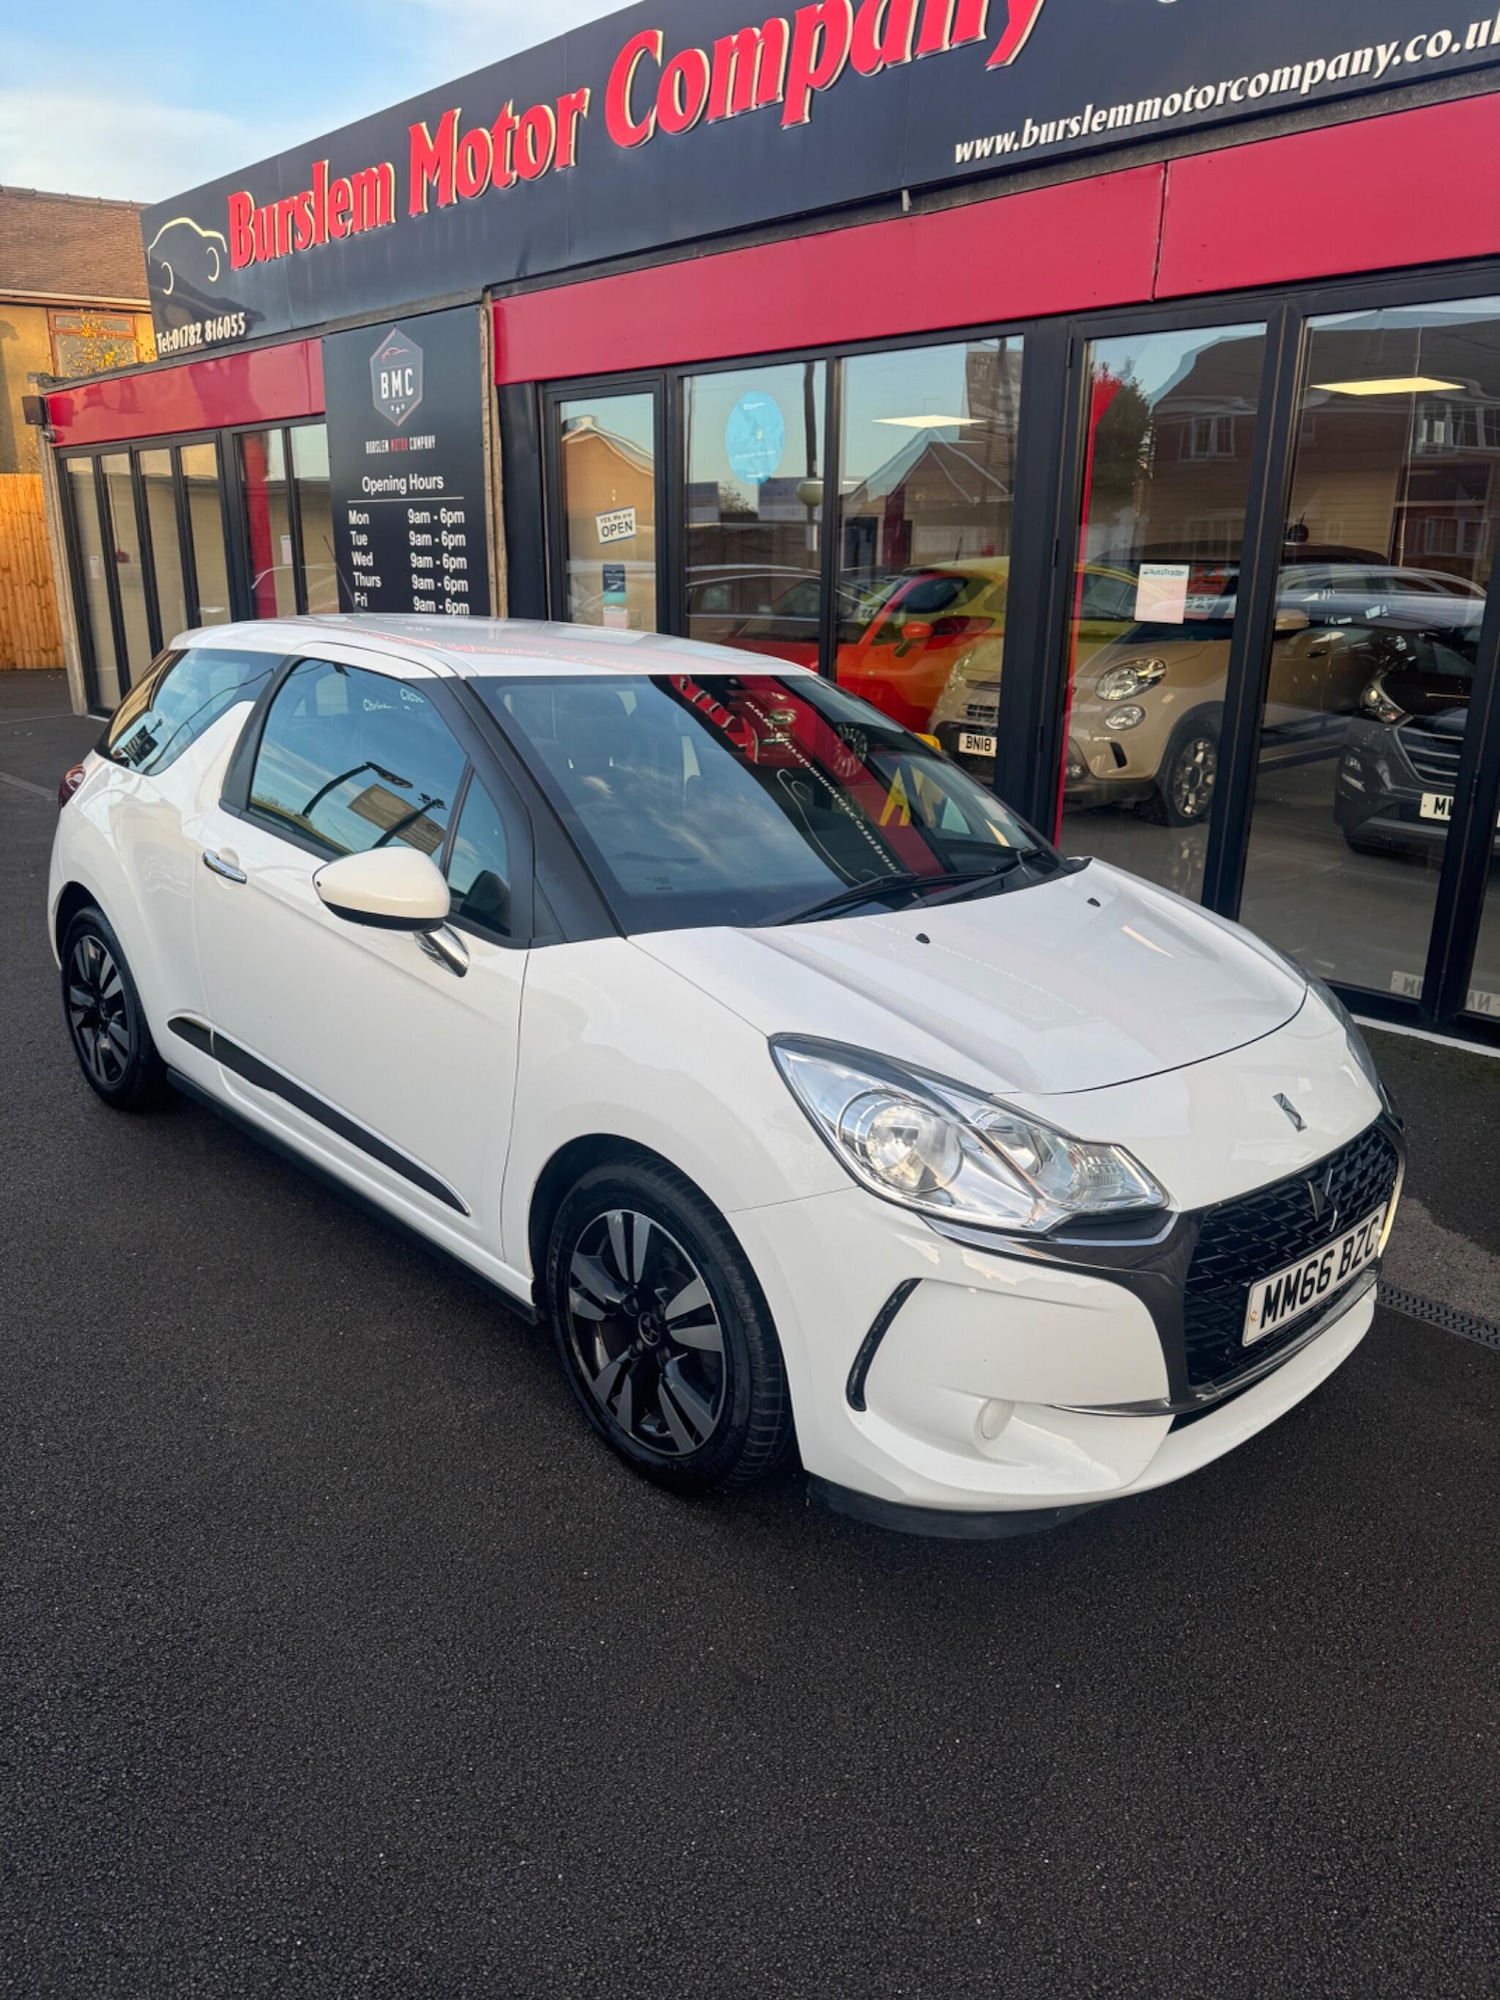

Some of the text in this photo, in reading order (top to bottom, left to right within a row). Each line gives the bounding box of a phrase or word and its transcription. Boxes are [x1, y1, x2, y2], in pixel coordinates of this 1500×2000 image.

[228, 159, 397, 270] Burslem
[408, 86, 591, 216] Motor
[156, 312, 247, 353] Tel:01782 816055
[380, 368, 414, 400] BMC
[362, 473, 444, 495] Opening Hours
[348, 510, 370, 526] Mon
[407, 508, 431, 525] 9am
[440, 508, 465, 531] 6pm
[601, 520, 633, 538] OPEN
[350, 531, 368, 547] Tue
[409, 531, 432, 547] 9am
[441, 531, 466, 553] 6pm
[351, 551, 373, 567] Wed
[410, 552, 433, 569] 9am
[443, 554, 467, 575] 6pm
[353, 573, 382, 589] Thurs
[411, 574, 435, 591] 9am
[444, 576, 468, 596] 6pm
[354, 592, 368, 608] Fri
[413, 596, 437, 613] 9am
[445, 598, 470, 616] 6pm
[965, 735, 992, 752] BN18
[1260, 1248, 1335, 1330] MM66
[1337, 1215, 1380, 1282] BZC
